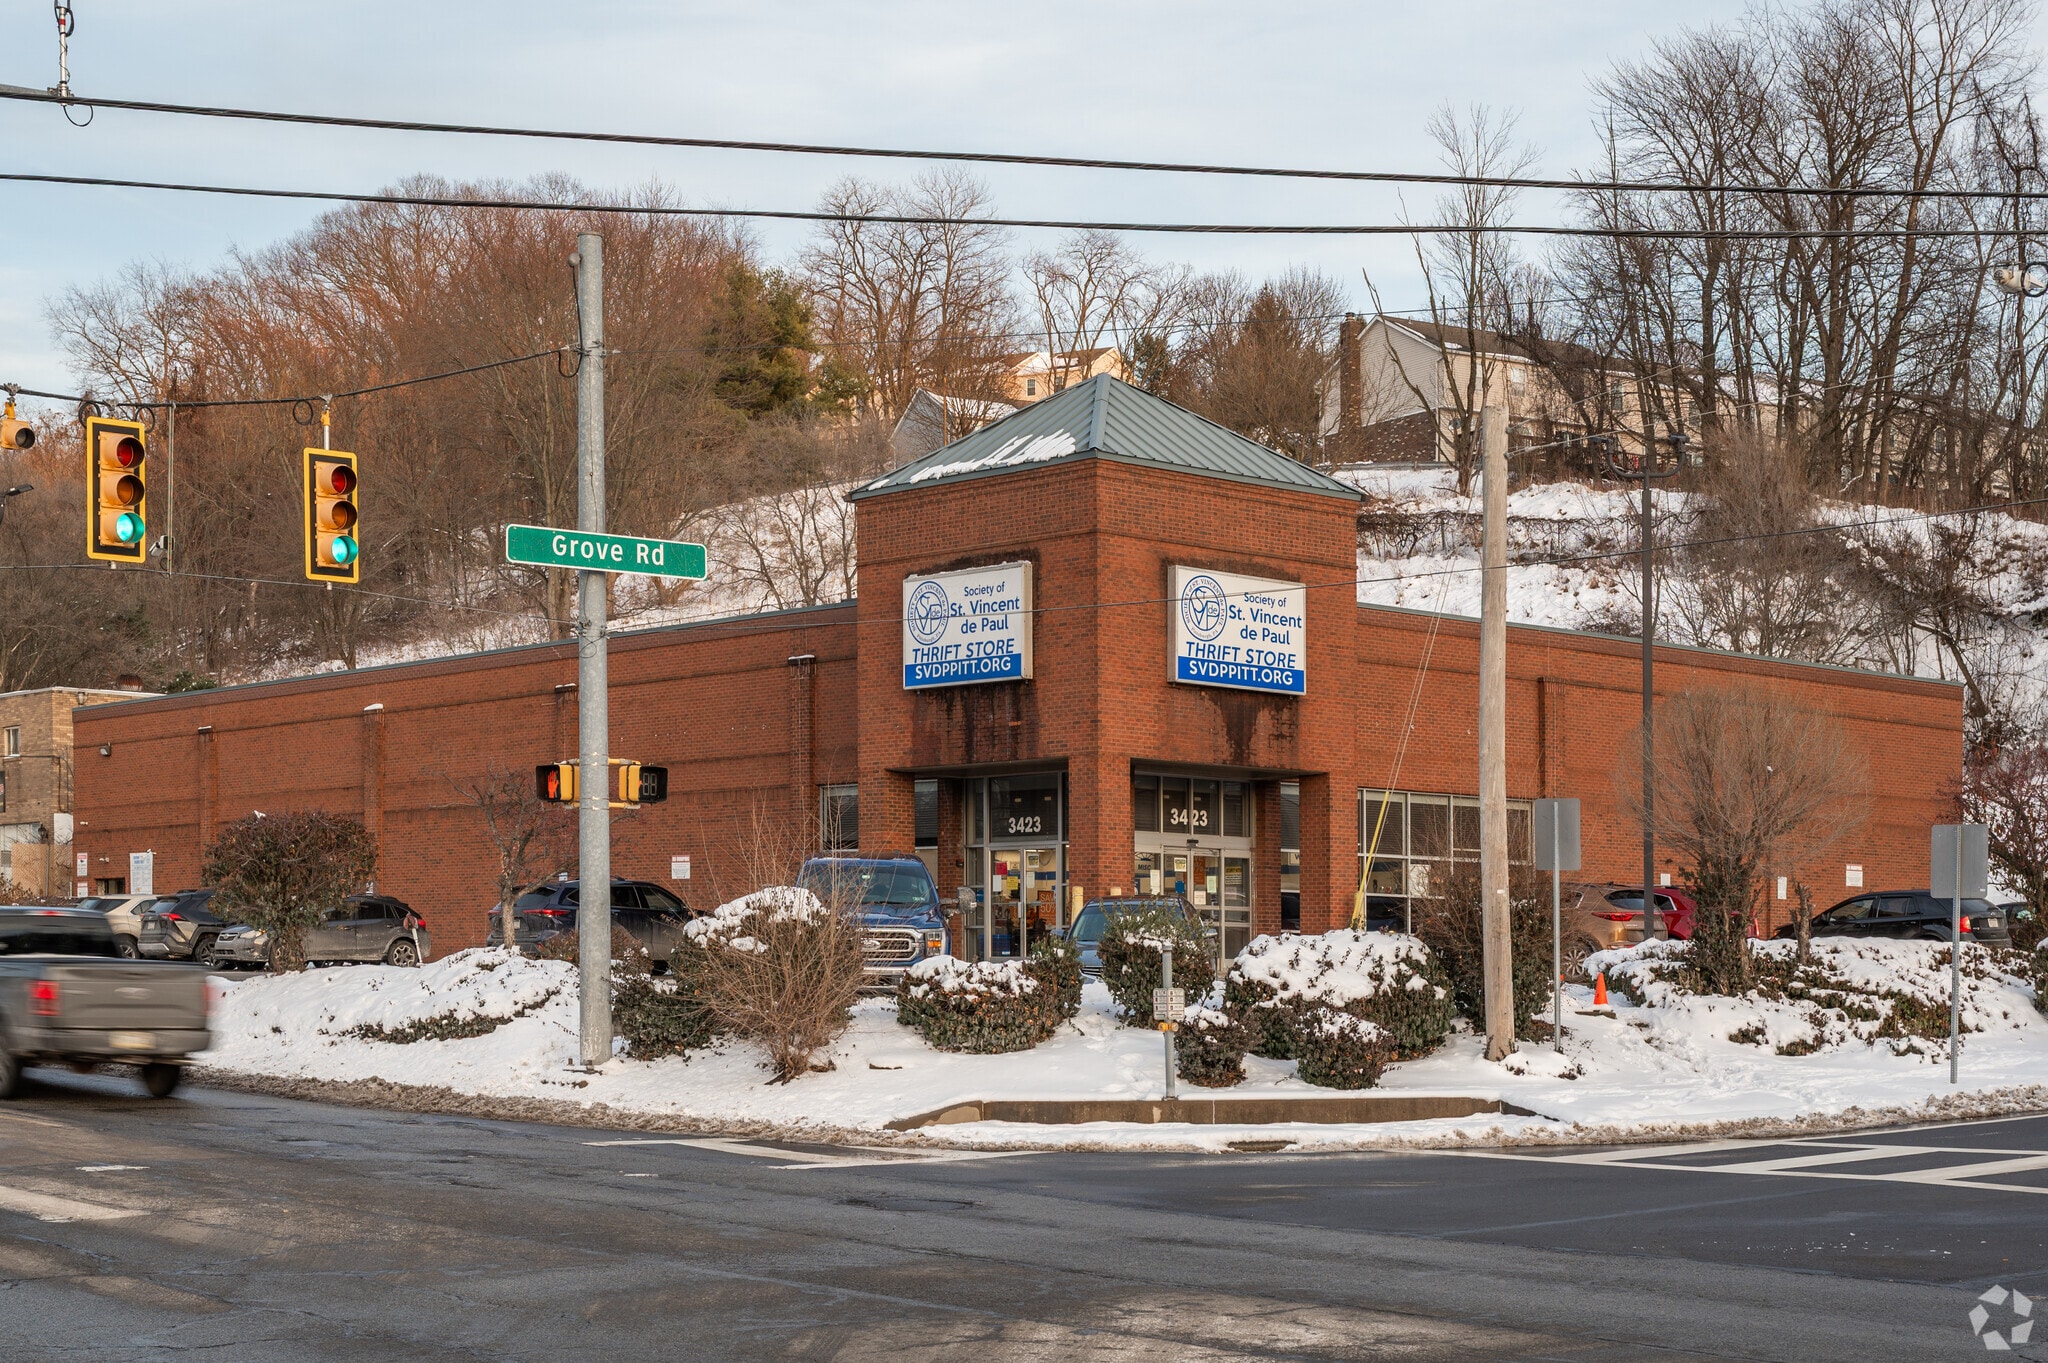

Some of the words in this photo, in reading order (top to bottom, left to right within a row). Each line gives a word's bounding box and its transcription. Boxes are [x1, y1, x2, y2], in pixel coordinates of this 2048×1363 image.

[552, 535, 623, 562] Grove
[636, 543, 664, 566] Rd
[964, 584, 994, 598] Society
[997, 581, 1005, 592] of
[1244, 592, 1275, 608] Society
[1278, 597, 1287, 607] of
[950, 602, 966, 617] St.
[970, 596, 1020, 614] Vincent
[1229, 605, 1246, 620] St.
[1250, 607, 1302, 628] Vincent
[961, 619, 977, 634] de
[982, 614, 1009, 632] Paul
[1240, 625, 1257, 640] de
[1262, 627, 1290, 645] Paul
[912, 644, 961, 663] THRIFT
[966, 638, 1015, 658] STORE
[1186, 641, 1241, 662] THRIFT
[1246, 648, 1296, 668] STORE
[915, 657, 1011, 679] SVDPPITT.ORG
[1189, 660, 1293, 685] SVDPPITT.ORG
[1008, 816, 1041, 834] 3423
[1170, 808, 1208, 826] 3423
